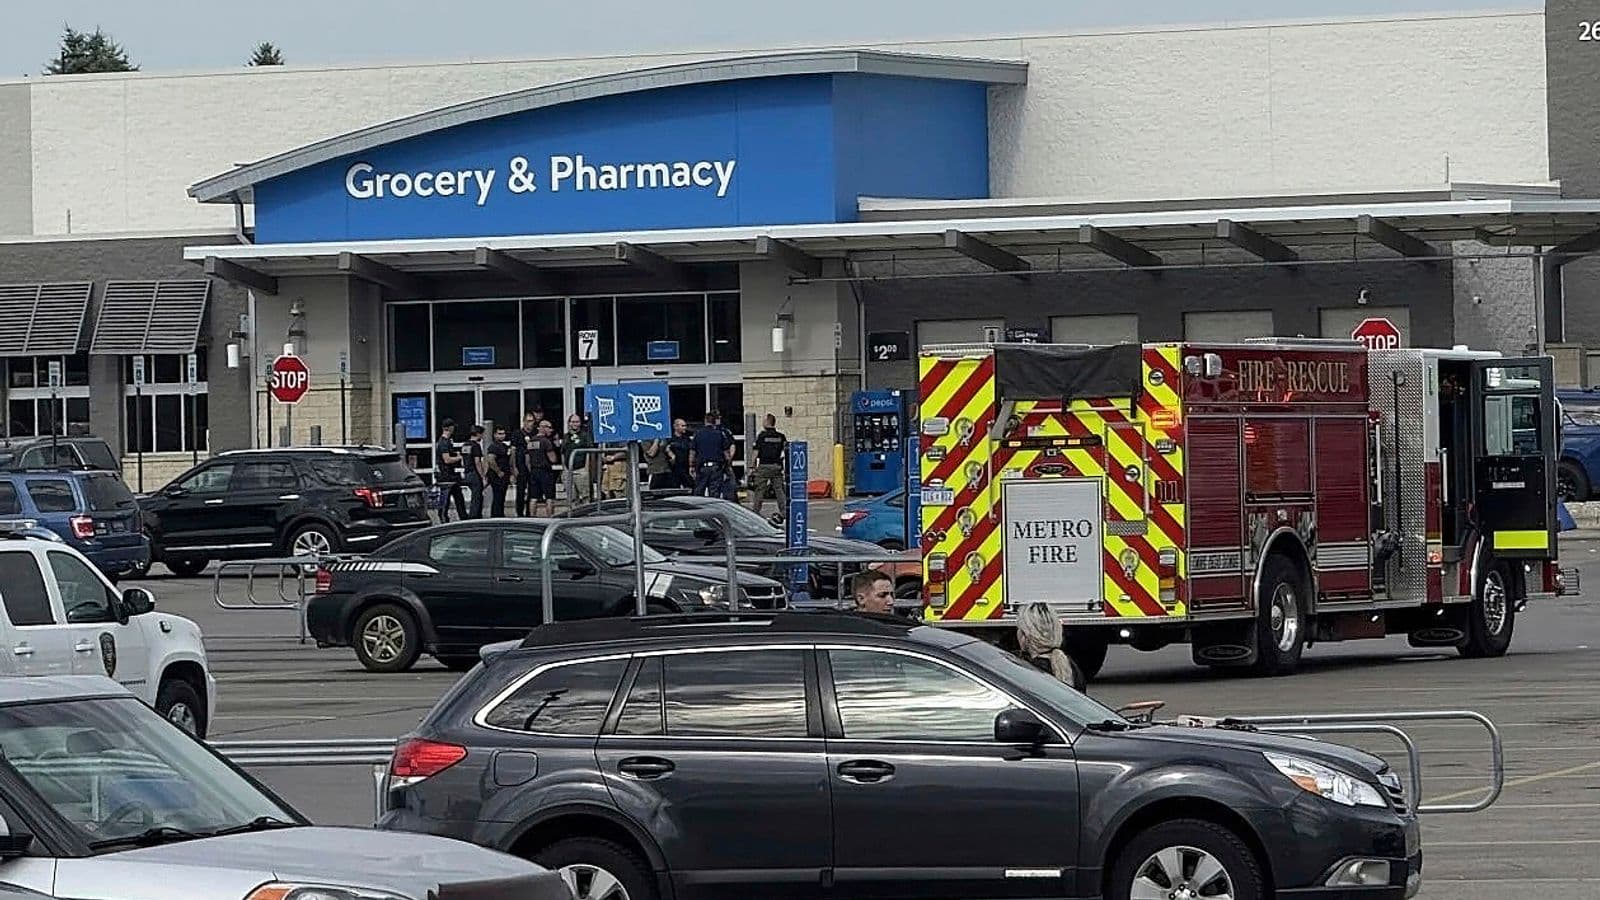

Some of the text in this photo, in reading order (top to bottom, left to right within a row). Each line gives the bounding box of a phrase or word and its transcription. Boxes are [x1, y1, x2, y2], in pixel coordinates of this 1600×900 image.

[346, 155, 736, 205] Grocery & Pharmacy
[582, 340, 594, 359] 7
[271, 370, 307, 389] STOP
[793, 451, 806, 470] 20
[1158, 480, 1181, 503] 11
[1013, 519, 1093, 539] METRO
[1028, 545, 1078, 563] FIRE
